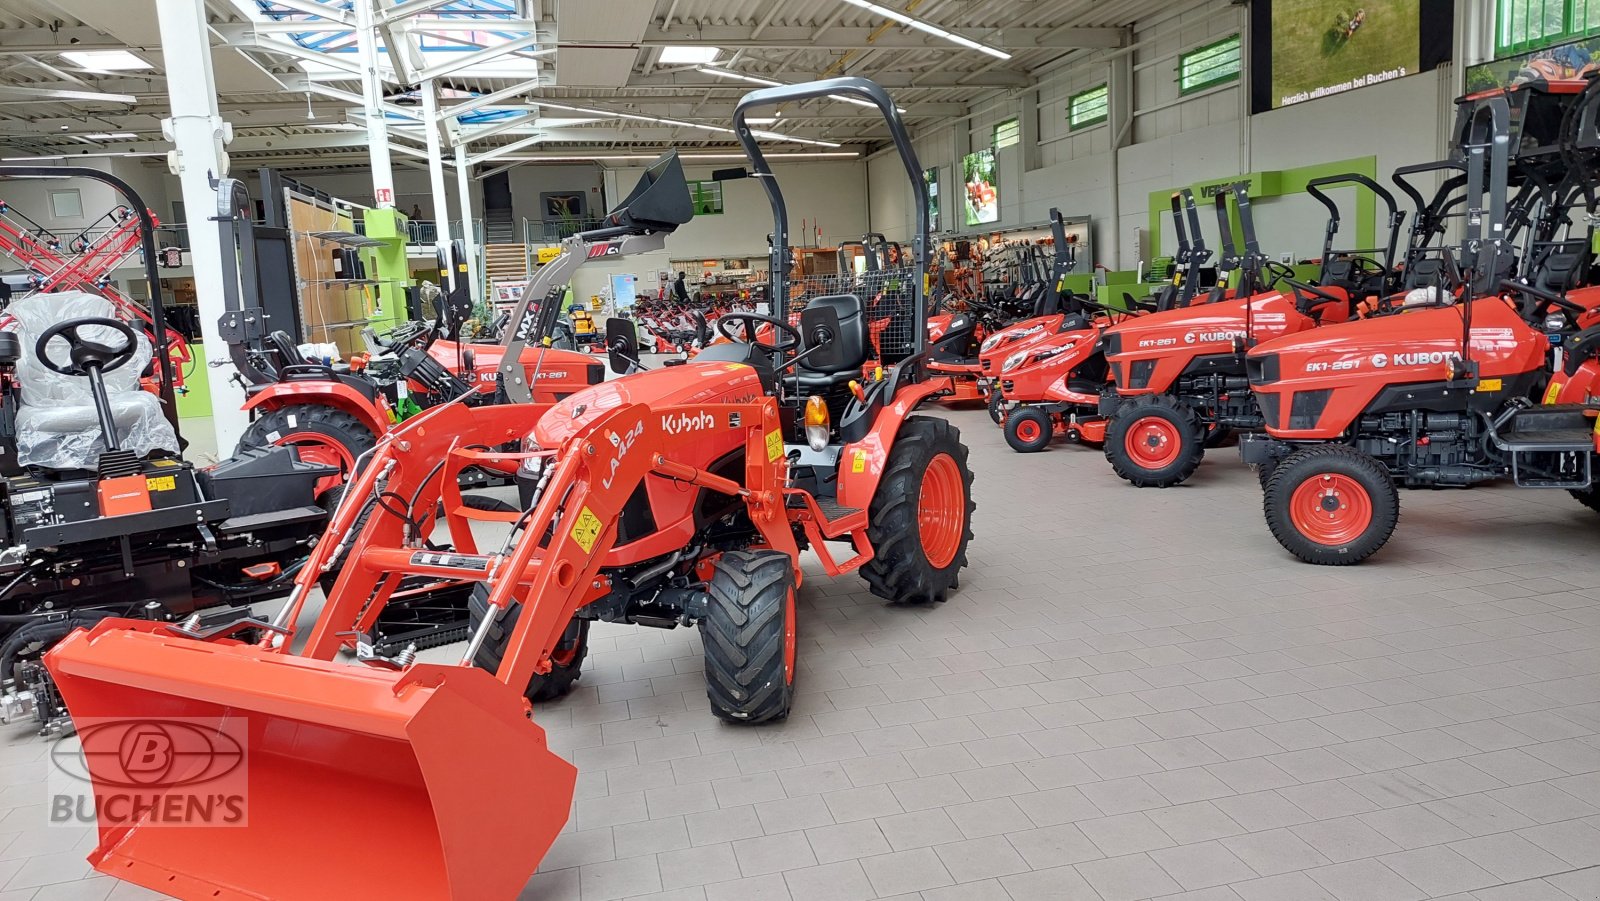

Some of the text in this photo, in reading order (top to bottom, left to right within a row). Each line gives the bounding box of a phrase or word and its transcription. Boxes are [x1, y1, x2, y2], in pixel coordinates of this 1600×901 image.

[1281, 92, 1309, 106] Herzlich
[1310, 81, 1352, 99] willkommen
[1353, 78, 1365, 88] bei
[516, 310, 535, 339] MX
[1199, 331, 1248, 342] KUBOTA
[1393, 351, 1463, 366] KUBOTA
[1306, 360, 1361, 372] EK1-261
[480, 372, 498, 381] KU
[532, 371, 568, 379] K1-261
[661, 410, 715, 435] Kubota
